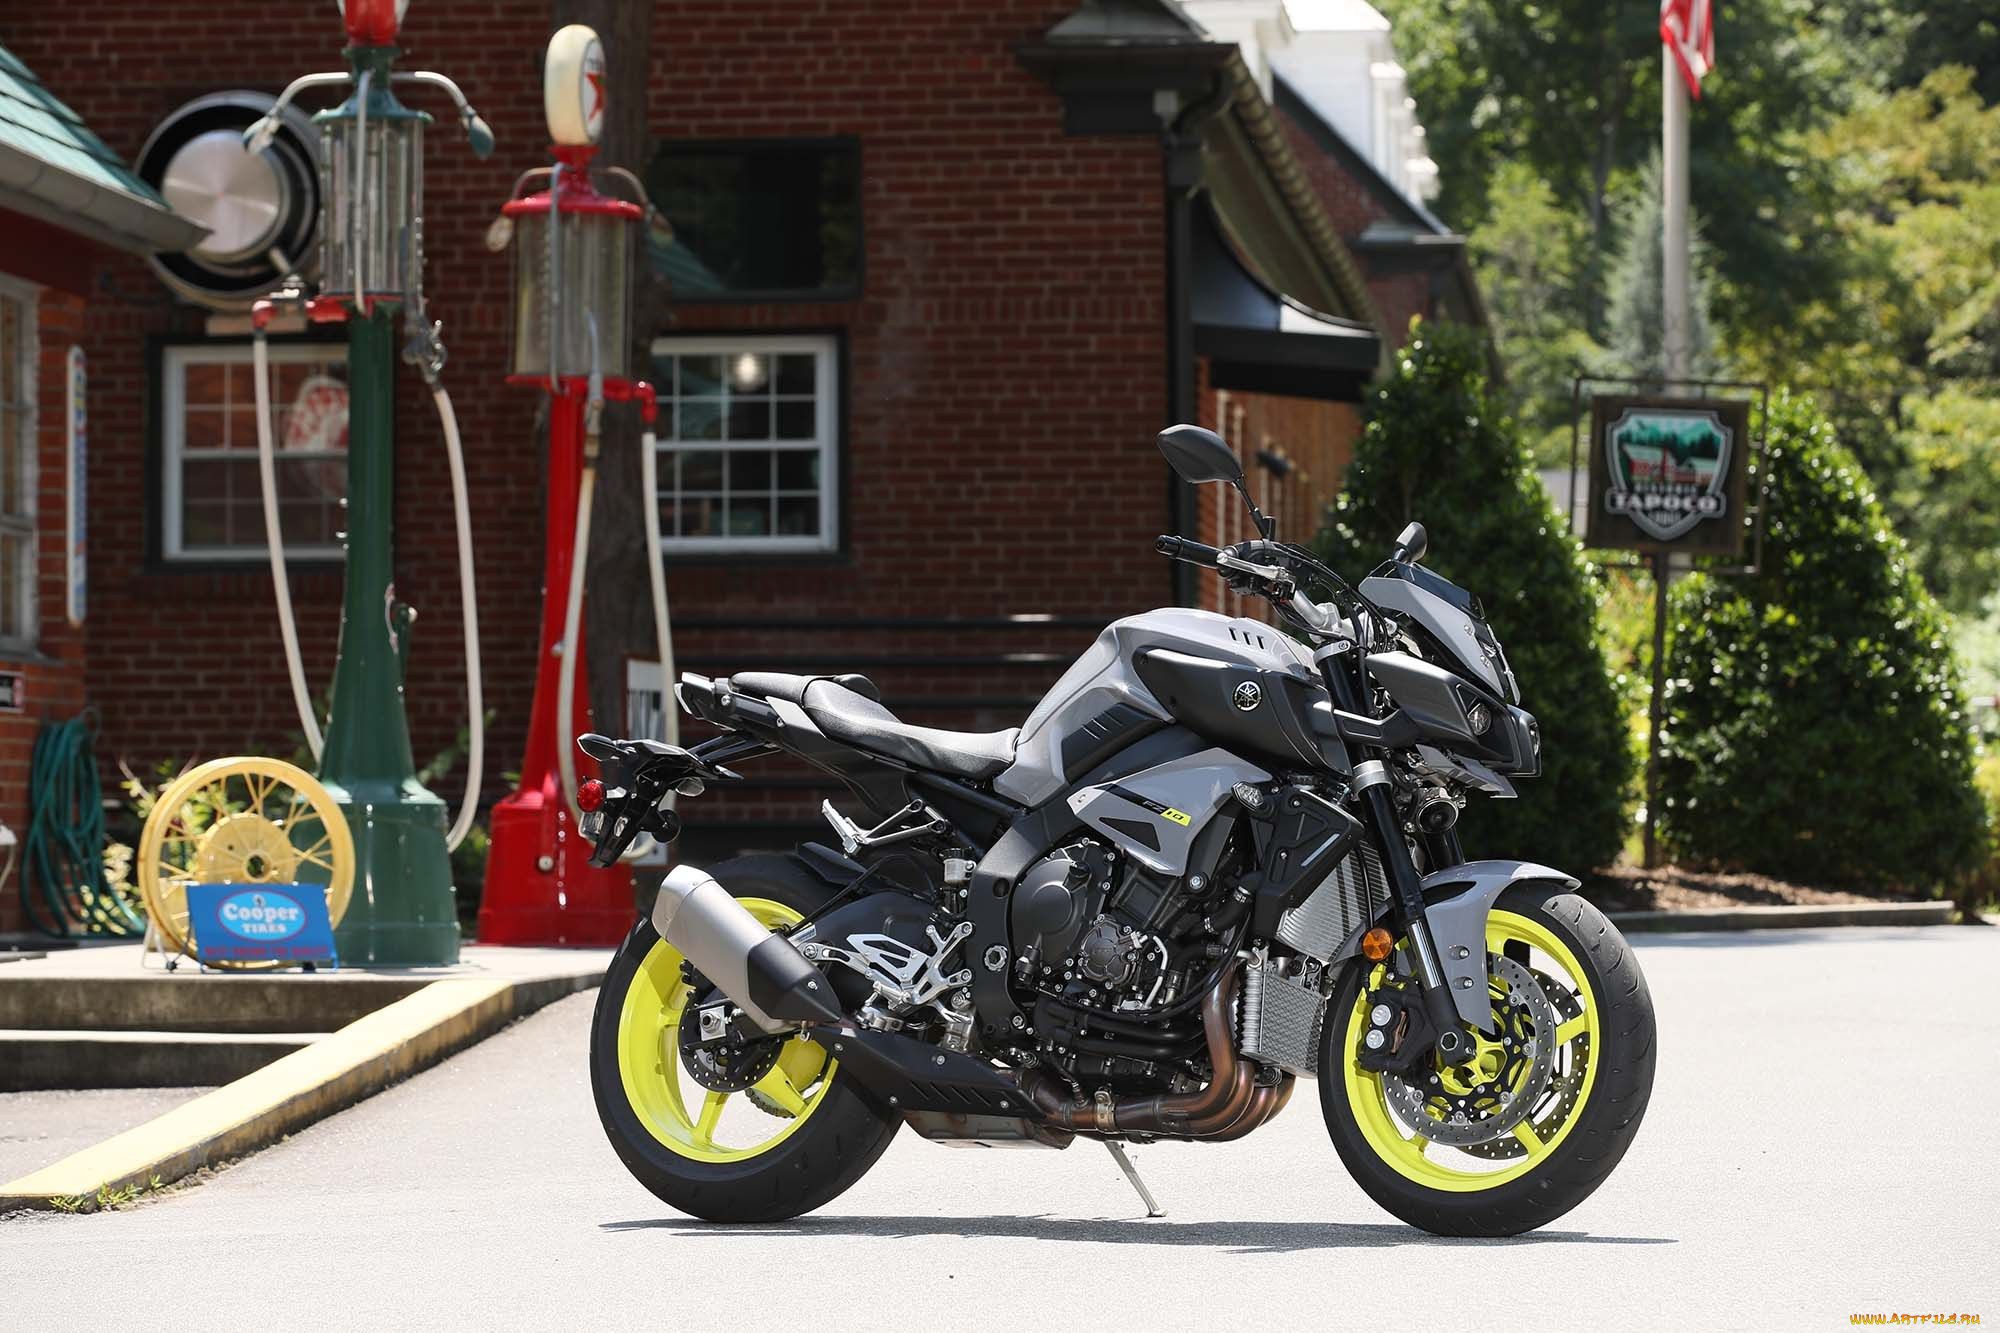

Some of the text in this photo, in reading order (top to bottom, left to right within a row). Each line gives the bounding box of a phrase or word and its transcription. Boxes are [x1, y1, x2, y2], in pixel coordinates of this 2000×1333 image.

[1615, 494, 1717, 512] TAPOCO
[222, 903, 299, 922] Cooper
[242, 924, 286, 933] TIRES
